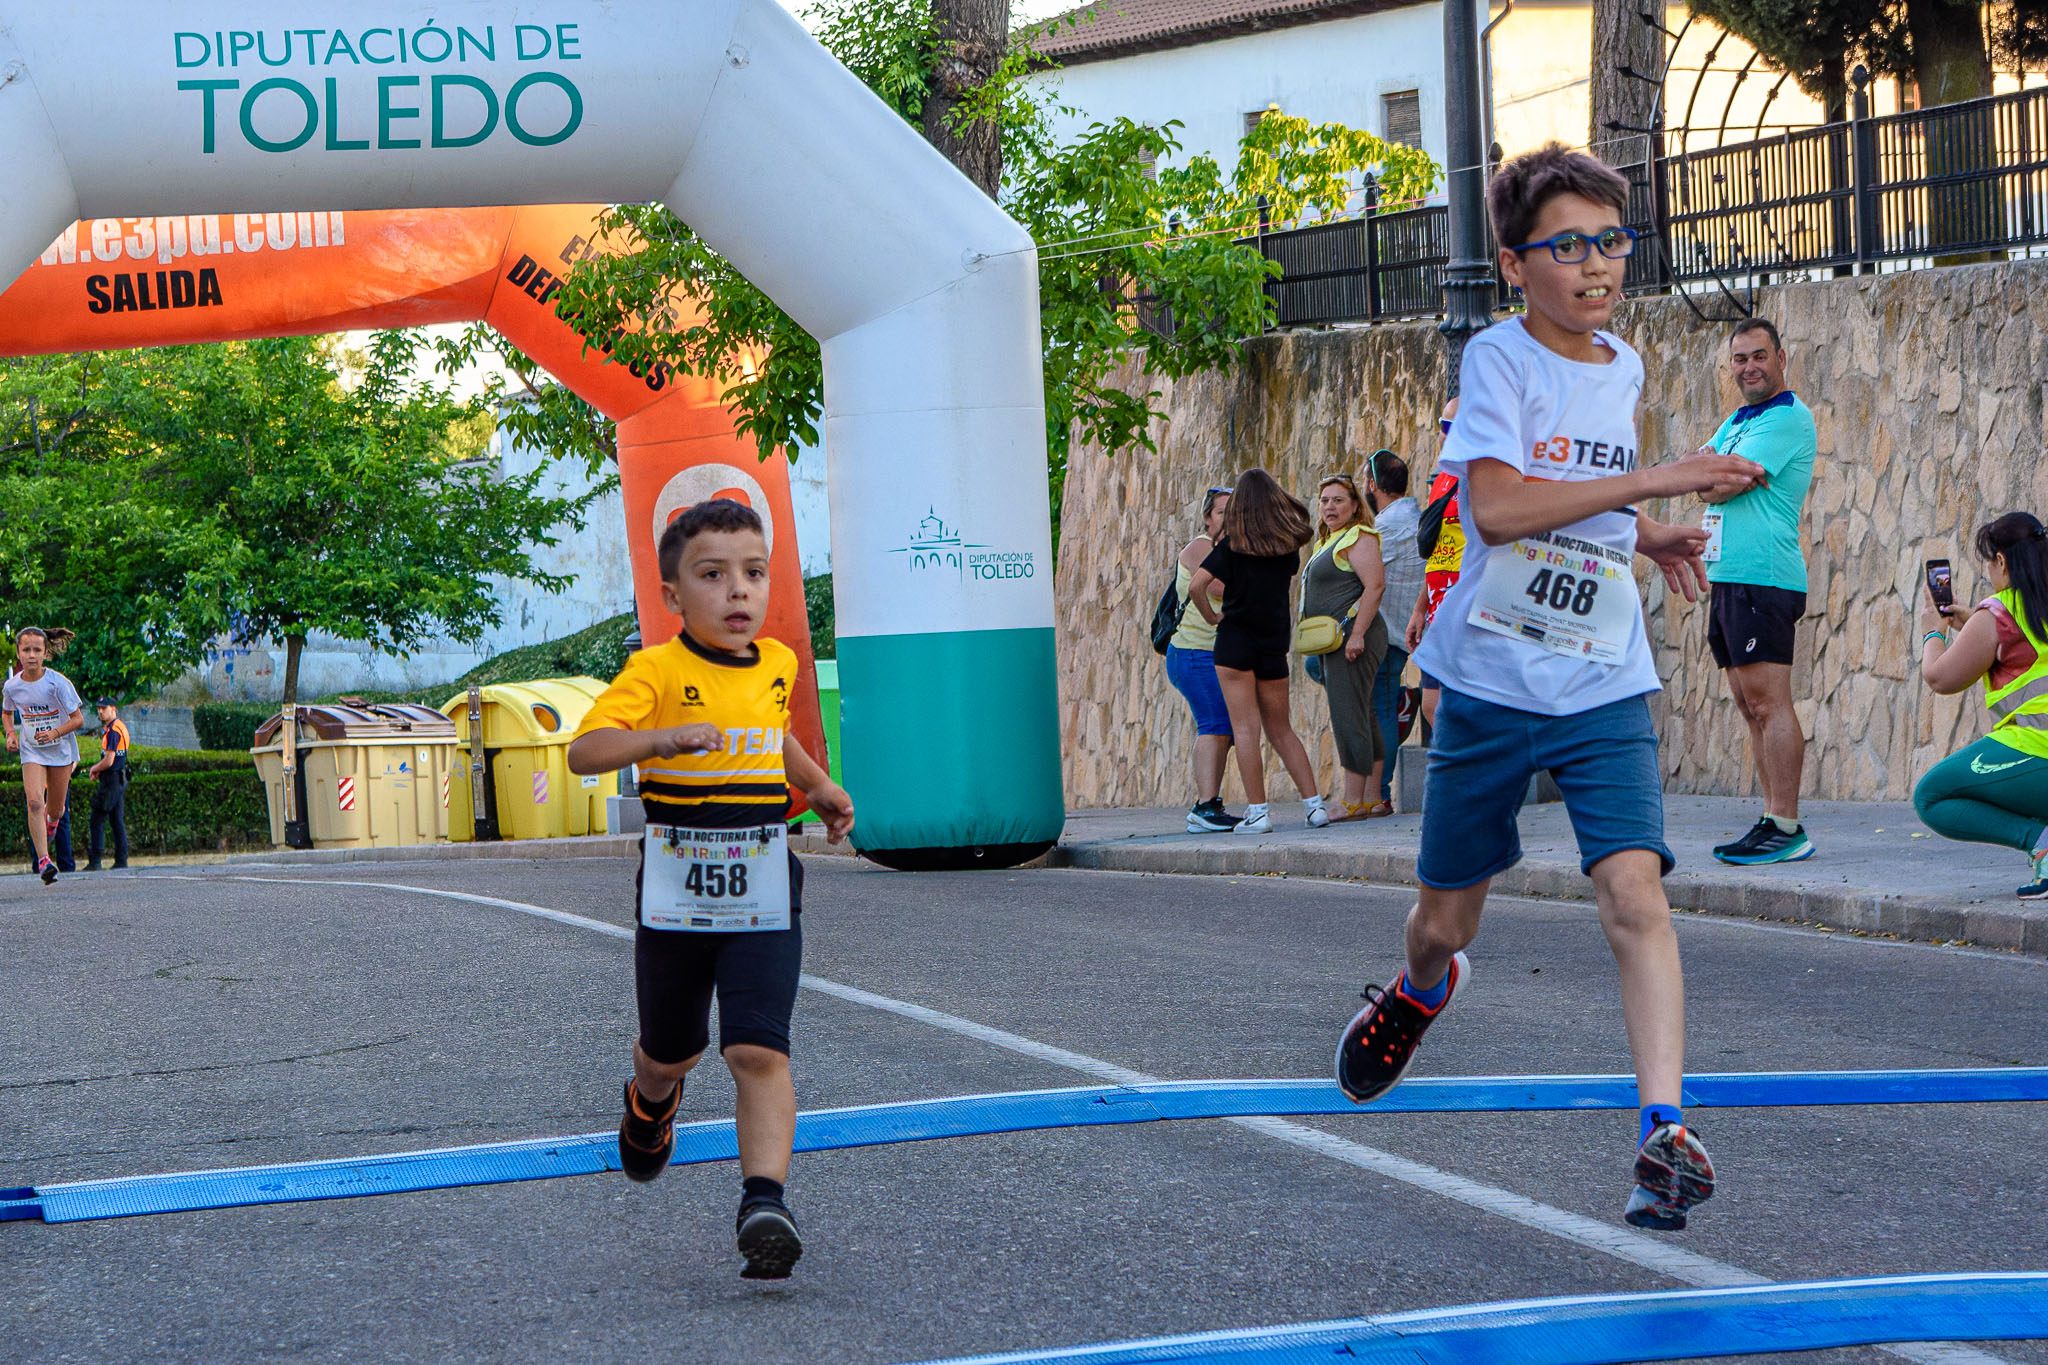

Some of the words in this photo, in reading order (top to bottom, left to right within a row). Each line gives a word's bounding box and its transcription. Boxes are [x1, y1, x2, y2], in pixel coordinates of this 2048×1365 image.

[174, 18, 496, 68] DIPUTACIÓN
[515, 23, 582, 61] DE
[177, 71, 584, 154] TOLEDO
[86, 268, 223, 314] SALIDA
[969, 552, 1022, 564] DIPUTACIÓN
[1024, 552, 1033, 562] DE
[1552, 534, 1604, 558] NOCTURNA
[970, 562, 1034, 580] TOLEDO
[1526, 568, 1599, 616] 468
[664, 827, 692, 841] LEUA
[694, 831, 747, 843] NOCTURNA
[749, 827, 779, 841] UGNA
[685, 863, 748, 899] 458
